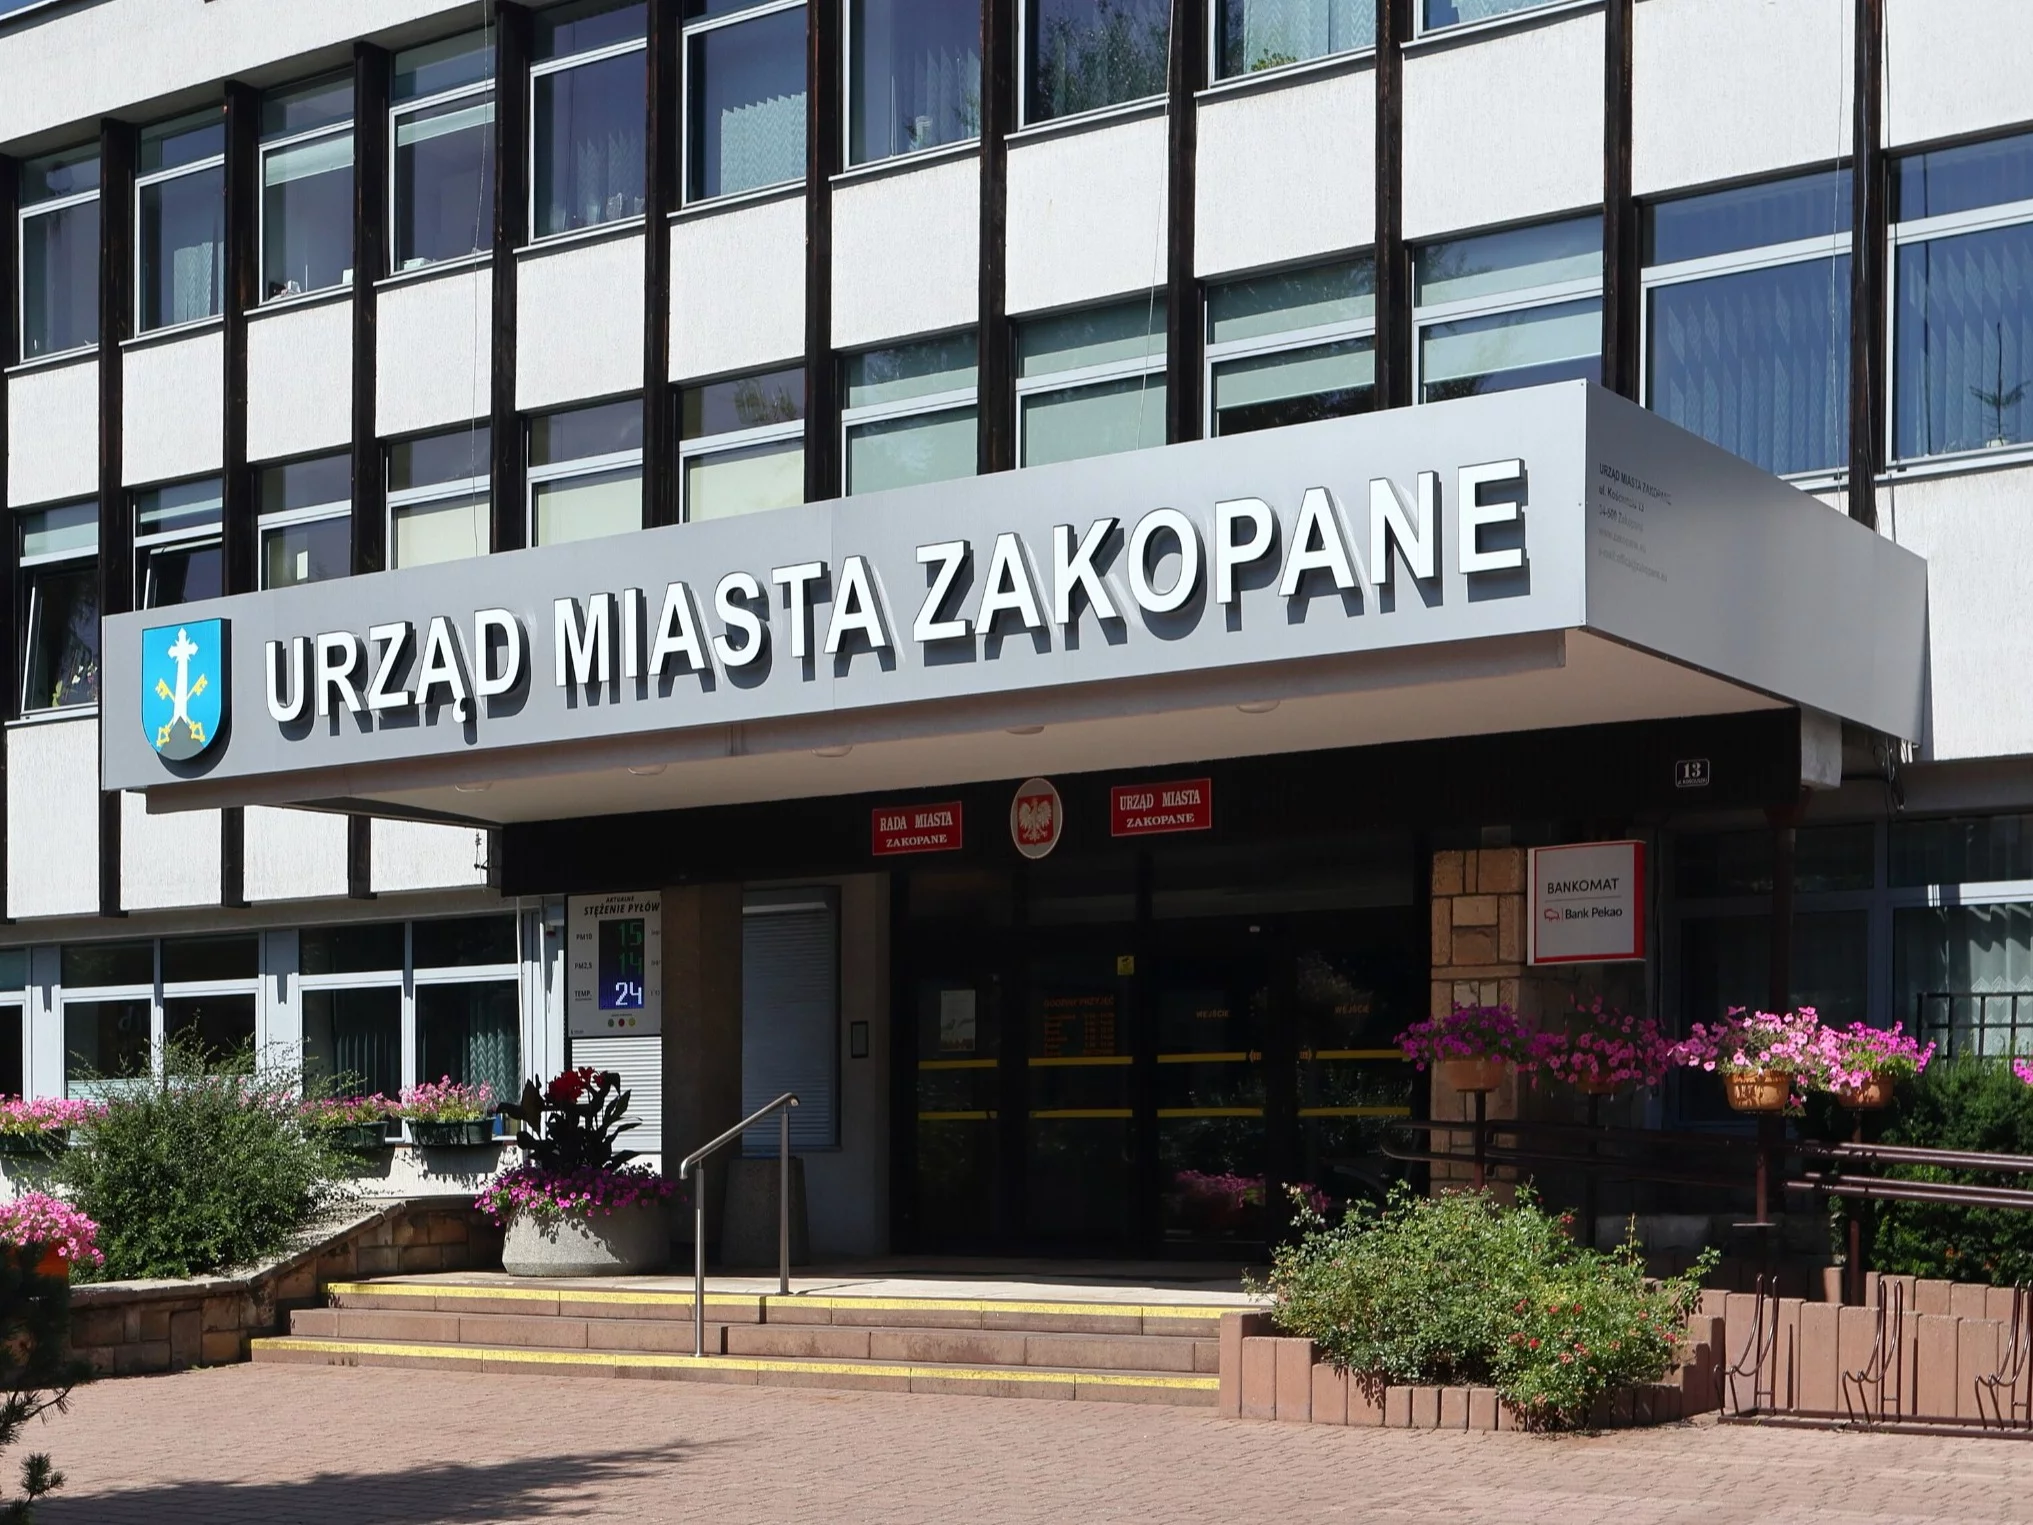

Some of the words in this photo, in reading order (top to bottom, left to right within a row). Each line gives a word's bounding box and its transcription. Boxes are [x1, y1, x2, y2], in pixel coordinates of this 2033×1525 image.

[1598, 463, 1620, 485] URZĄD
[1620, 472, 1642, 491] MIASTA
[264, 607, 525, 724] URZĄD
[553, 554, 893, 688] MIASTA
[912, 457, 1527, 643] ZAKOPANE
[1684, 762, 1701, 778] 13
[1119, 793, 1154, 812] URZĄD
[1161, 789, 1202, 808] MIASTA
[879, 816, 908, 832] RADA
[914, 810, 954, 828] MIASTA
[1126, 813, 1195, 829] ZAKOPANE
[885, 833, 948, 848] ZAKOPANE
[1547, 878, 1620, 895] BANKOMAT
[584, 902, 625, 918] STĘŻENIE
[627, 901, 660, 914] PYŁÓW
[1564, 907, 1589, 921] Bank
[1591, 906, 1623, 919] Pekao
[576, 931, 593, 941] PM10
[617, 922, 643, 946] 15
[618, 951, 643, 976] 14
[574, 989, 593, 998] TEMP.
[615, 981, 643, 1006] 24
